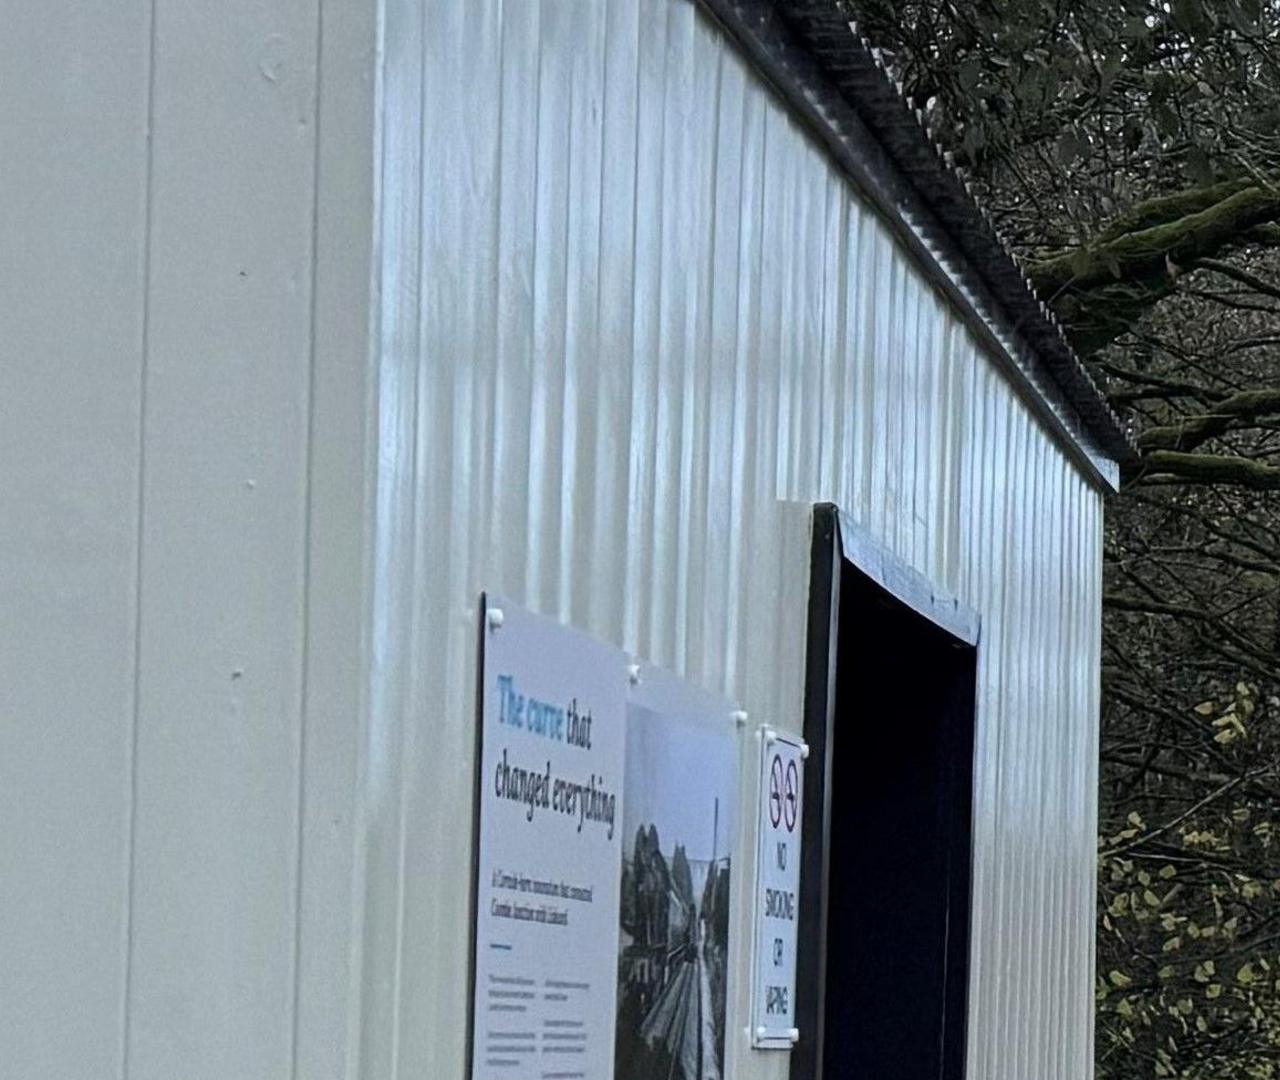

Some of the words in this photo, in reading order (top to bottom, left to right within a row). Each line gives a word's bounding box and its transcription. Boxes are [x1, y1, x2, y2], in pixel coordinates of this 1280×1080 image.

[497, 674, 524, 728] The
[527, 696, 565, 741] curve
[566, 698, 593, 750] that
[494, 748, 552, 822] changed
[552, 774, 616, 841] everything
